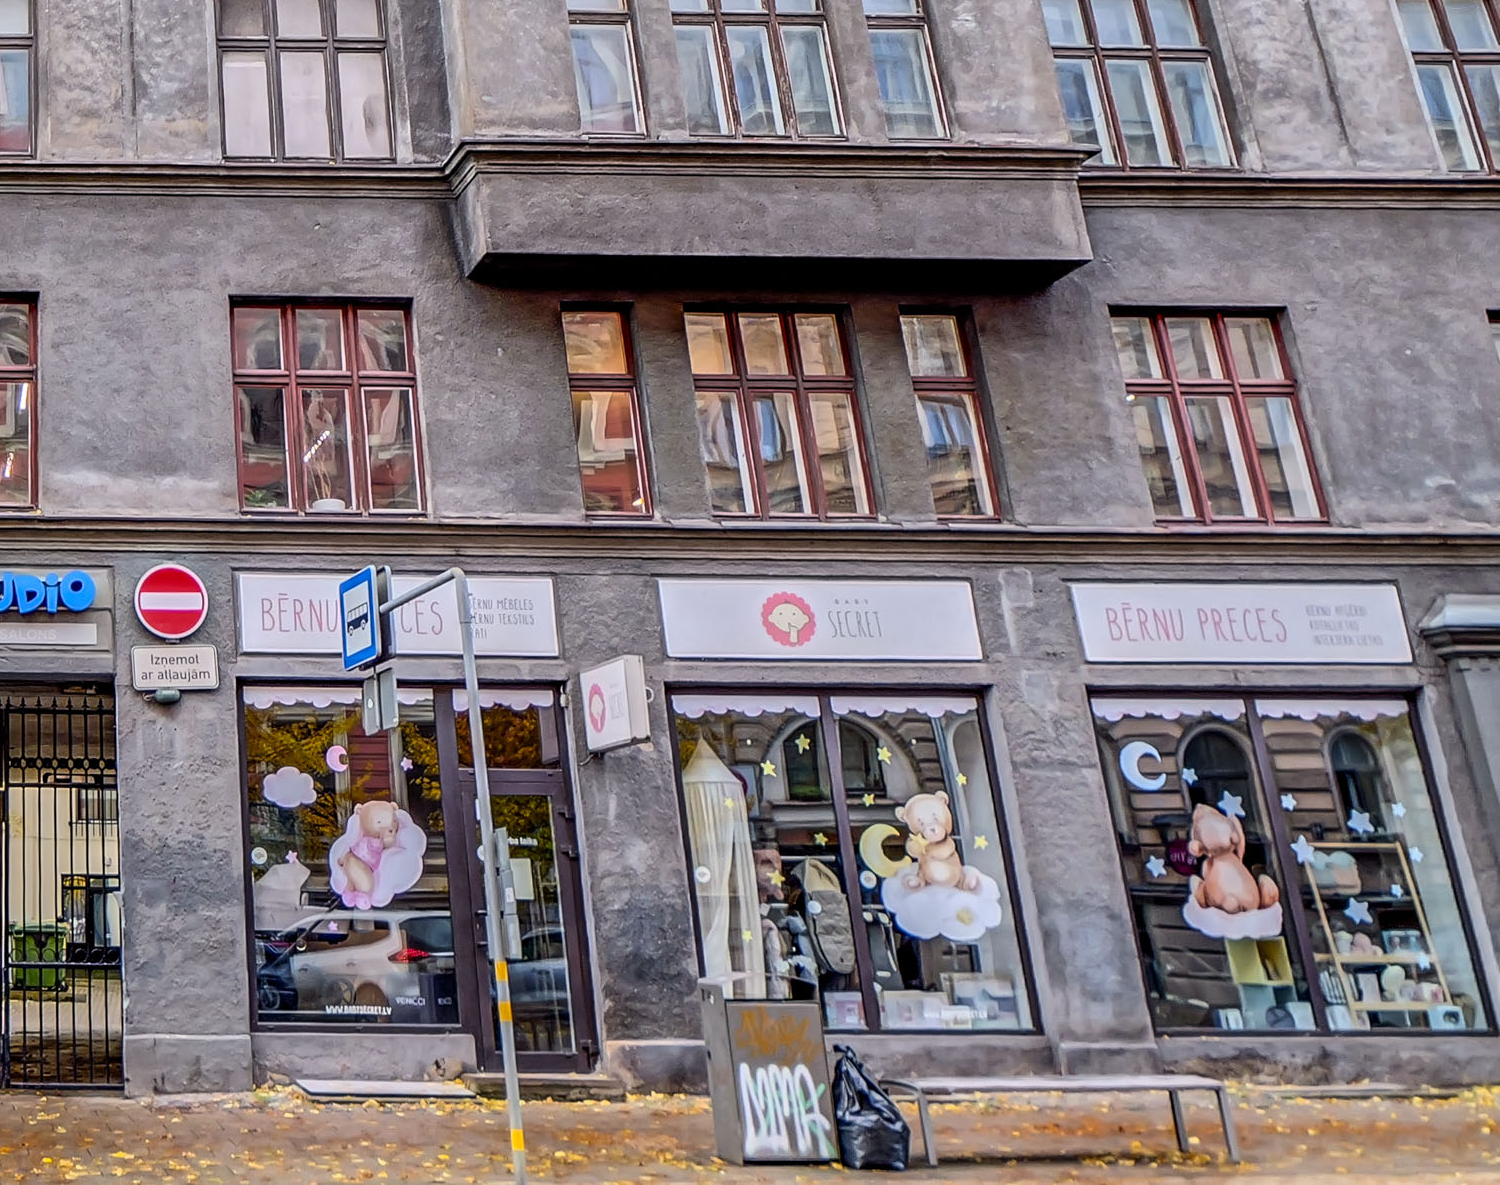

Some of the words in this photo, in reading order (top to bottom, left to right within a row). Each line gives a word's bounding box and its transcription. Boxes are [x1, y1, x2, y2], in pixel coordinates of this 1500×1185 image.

[472, 597, 493, 611] ĒRNU
[261, 593, 338, 633] BĒRNU
[400, 600, 443, 635] CES
[474, 612, 495, 625] ĒRNU
[827, 610, 883, 638] SECRET
[1105, 602, 1185, 642] BĒRNU
[1197, 607, 1288, 643] PRECES
[0, 628, 57, 641] SALONS
[475, 628, 488, 639] ATI
[141, 671, 154, 680] ar
